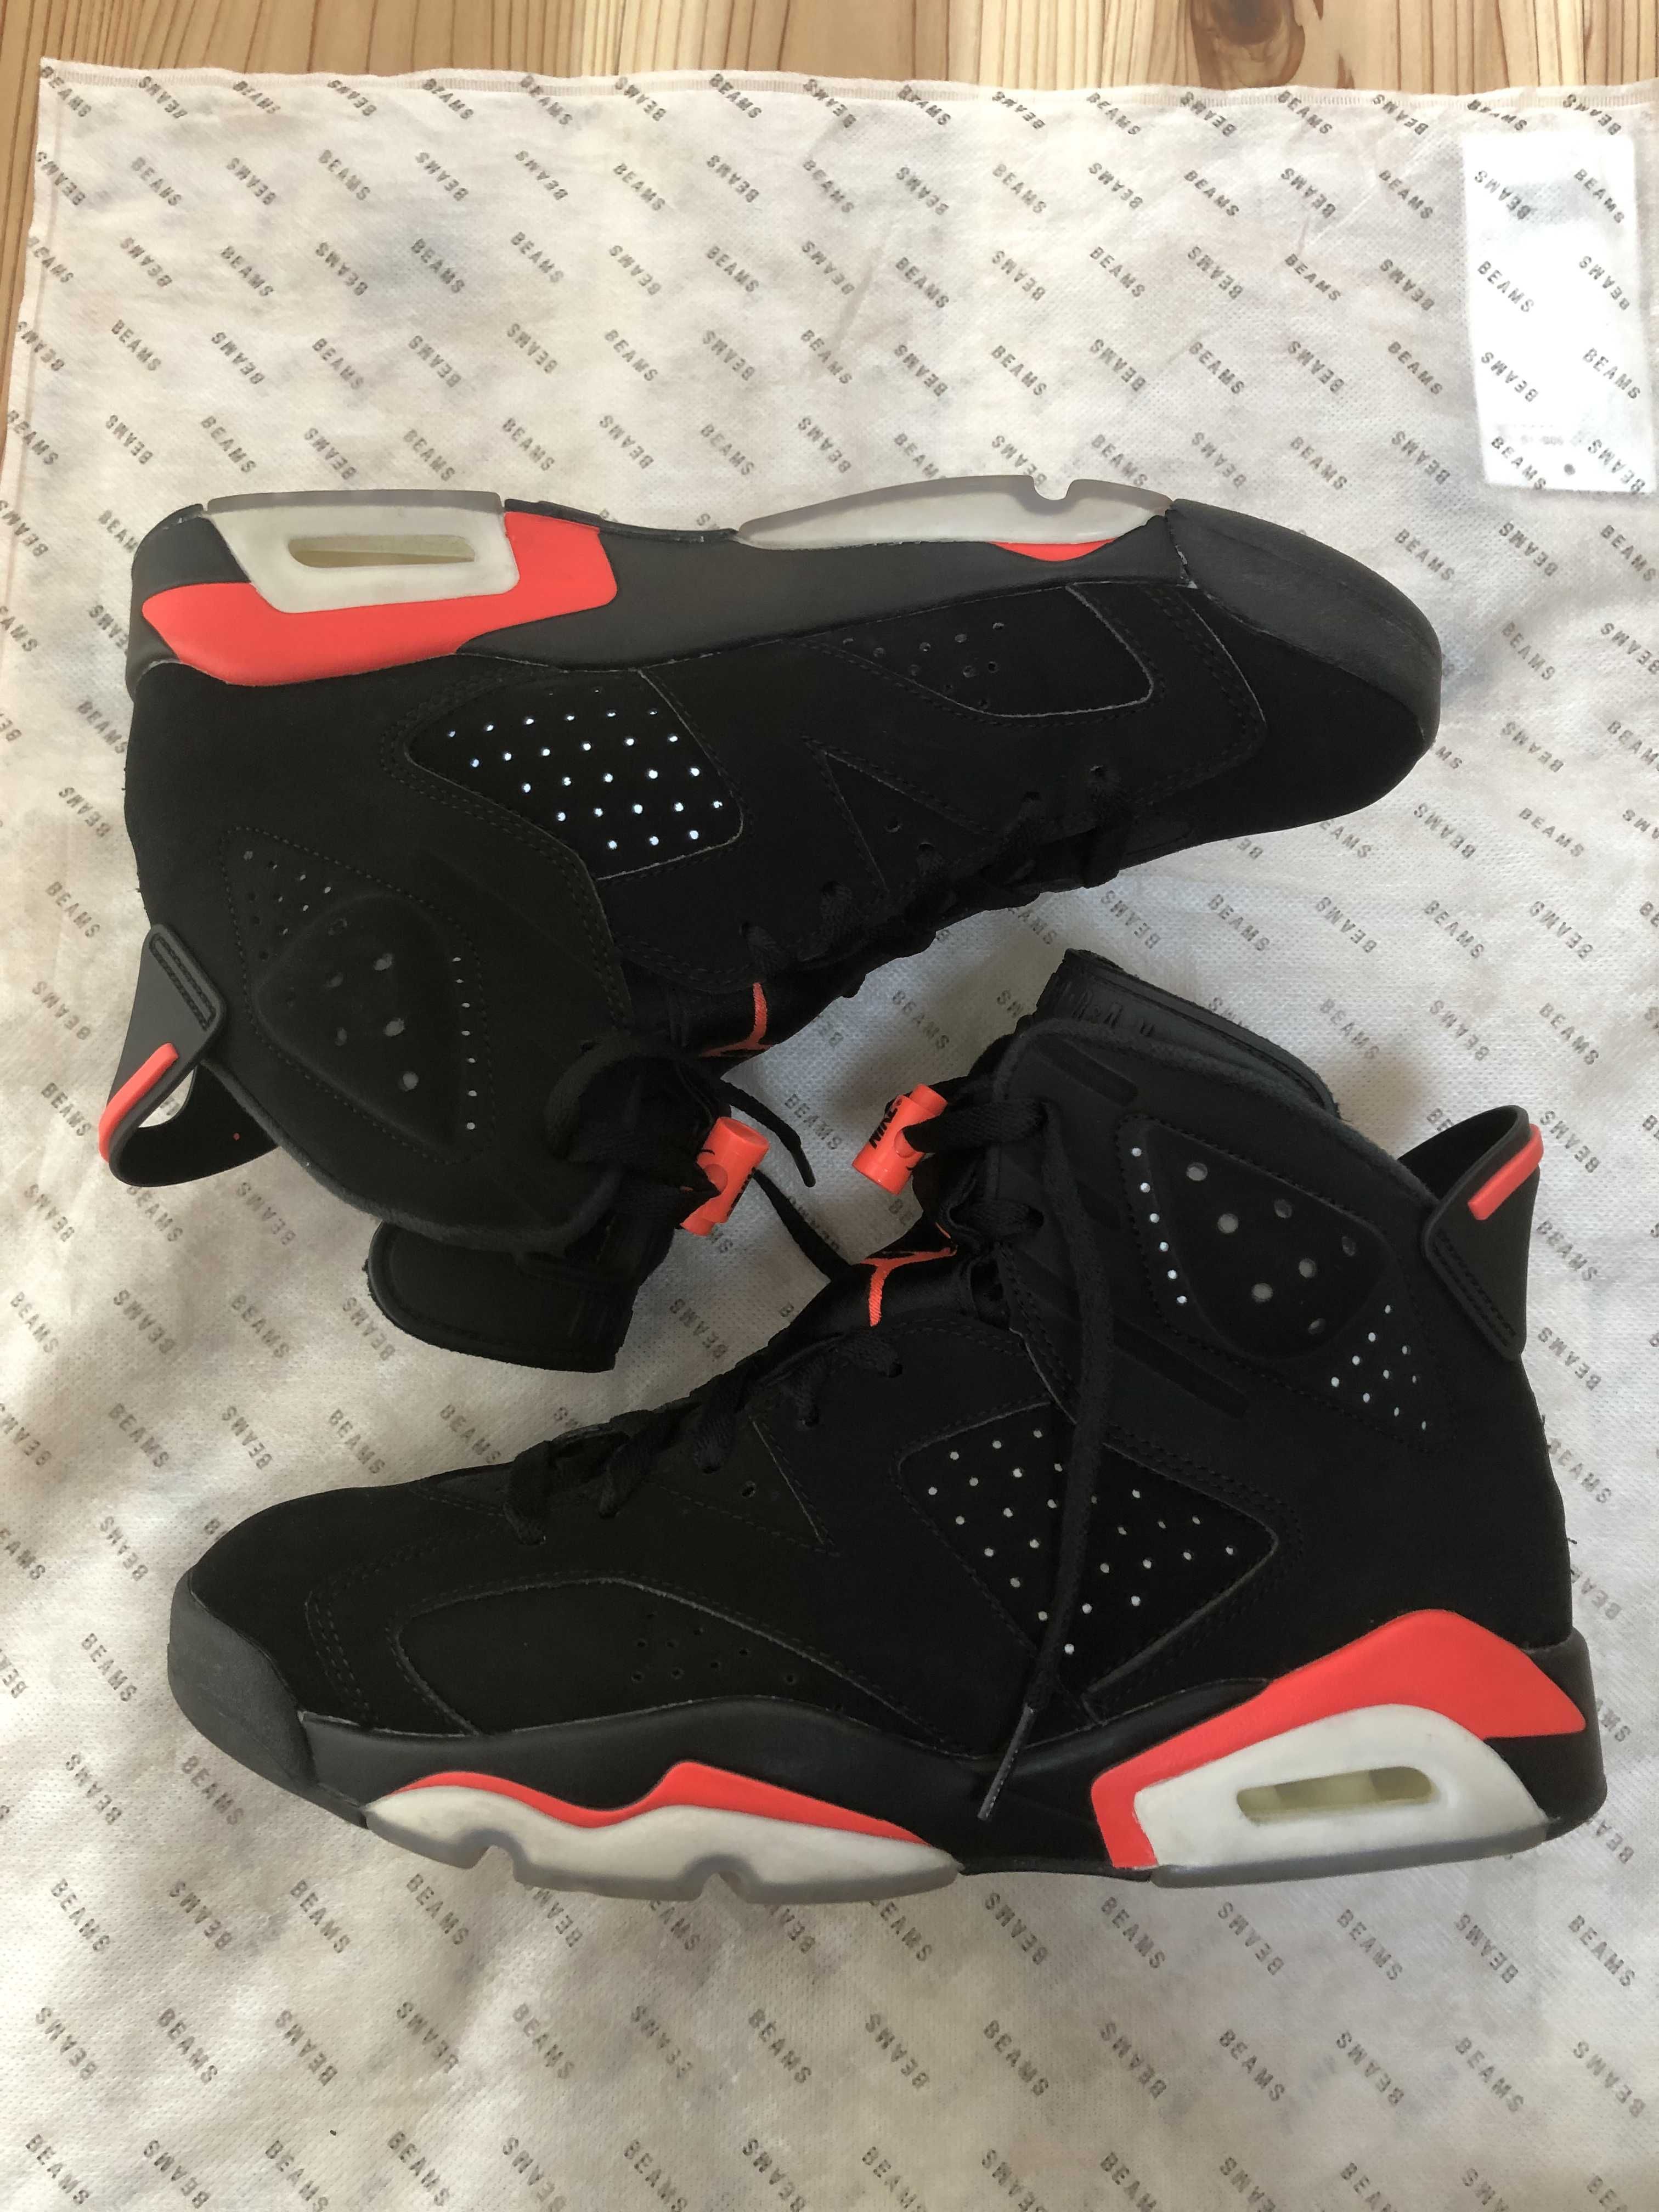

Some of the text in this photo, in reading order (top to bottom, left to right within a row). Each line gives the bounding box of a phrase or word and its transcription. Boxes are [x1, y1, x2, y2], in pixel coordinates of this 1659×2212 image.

[40, 66, 92, 117] BEAMS
[709, 74, 763, 119] BEAMS
[1086, 92, 1142, 136] BEAMS
[1278, 89, 1333, 135] BEAMS
[36, 151, 86, 206] BEAMS
[132, 157, 182, 206] BEAMS
[227, 158, 277, 205] BEAMS
[319, 150, 370, 201] BEAMS
[416, 153, 469, 201] BEAMS
[515, 151, 568, 200] BEAMS
[613, 163, 665, 211] BEAMS
[707, 155, 759, 202] BEAMS
[803, 160, 854, 213] BEAMS
[896, 167, 949, 215] BEAMS
[993, 165, 1046, 213] BEAMS
[1089, 163, 1143, 209] BEAMS
[1184, 170, 1239, 217] BEAMS
[1281, 168, 1336, 219] BEAMS
[1379, 170, 1433, 219] BEAMS
[1474, 170, 1532, 220] BEAMS
[1574, 168, 1625, 224] BEAMS
[121, 238, 172, 287] BEAMS
[221, 246, 274, 296] BEAMS
[315, 242, 368, 296] BEAMS
[411, 239, 465, 293] BEAMS
[511, 232, 562, 283] BEAMS
[610, 246, 661, 295] BEAMS
[706, 246, 759, 292] BEAMS
[802, 241, 855, 294] BEAMS
[895, 257, 949, 309] BEAMS
[992, 251, 1045, 301] BEAMS
[1090, 247, 1144, 297] BEAMS
[1187, 246, 1243, 300] BEAMS
[1284, 253, 1341, 301] BEAMS
[1579, 256, 1629, 310] BEAMS
[1380, 259, 1435, 311] BEAMS
[1478, 261, 1534, 313] BEAMS
[17, 321, 65, 371] BEAMS
[111, 320, 161, 371] BEAMS
[211, 332, 265, 385] BEAMS
[313, 338, 364, 390] BEAMS
[409, 336, 461, 388] BEAMS
[507, 323, 557, 373] BEAMS
[605, 330, 657, 381] BEAMS
[703, 331, 755, 381] BEAMS
[802, 330, 851, 384] BEAMS
[894, 344, 947, 398] BEAMS
[991, 345, 1047, 396] BEAMS
[1090, 339, 1146, 393] BEAMS
[1189, 341, 1245, 394] BEAMS
[1286, 341, 1345, 394] BEAMS
[1388, 342, 1442, 395] BEAMS
[1481, 352, 1537, 402] BEAMS
[1583, 348, 1640, 399] BEAMS
[8, 410, 59, 465] BEAMS
[106, 415, 153, 465] BEAMS
[201, 416, 256, 473] BEAMS
[305, 428, 357, 479] BEAMS
[404, 430, 455, 481] BEAMS
[502, 418, 555, 470] BEAMS
[600, 416, 653, 469] BEAMS
[701, 425, 754, 475] BEAMS
[798, 417, 851, 472] BEAMS
[1091, 434, 1148, 487] BEAMS
[1192, 433, 1246, 488] BEAMS
[1290, 437, 1347, 489] BEAMS
[1392, 432, 1451, 484] BEAMS
[1491, 436, 1547, 490] BEAMS
[1587, 438, 1646, 495] BEAMS
[1395, 529, 1454, 580] BEAMS
[1499, 522, 1558, 577] BEAMS
[1600, 525, 1656, 582] BEAMS
[1502, 621, 1554, 680] BEAMS
[1502, 722, 1564, 772] BEAMS
[59, 787, 111, 838] BEAMS
[1414, 804, 1476, 859] BEAMS
[1519, 808, 1584, 857] BEAMS
[47, 882, 100, 937] BEAMS
[1101, 889, 1161, 949] BEAMS
[1209, 894, 1269, 951] BEAMS
[1316, 897, 1376, 953] BEAMS
[1423, 900, 1484, 959] BEAMS
[1530, 901, 1593, 959] BEAMS
[1430, 1001, 1489, 1060] BEAMS
[1540, 1003, 1599, 1065] BEAMS
[41, 1082, 91, 1136] BEAMS
[785, 1093, 843, 1151] BEAMS
[1540, 1110, 1601, 1173] BEAMS
[24, 1183, 75, 1243] BEAMS
[235, 1182, 297, 1246] BEAMS
[1537, 1220, 1598, 1282] BEAMS
[10, 1291, 59, 1354] BEAMS
[114, 1290, 176, 1355] BEAMS
[232, 1296, 289, 1358] BEAMS
[342, 1296, 396, 1362] BEAMS
[1538, 1327, 1602, 1391] BEAMS
[109, 1403, 170, 1468] BEAMS
[221, 1405, 273, 1470] BEAMS
[329, 1409, 385, 1474] BEAMS
[101, 1517, 148, 1581] BEAMS
[82, 1633, 137, 1701] BEAMS
[65, 1754, 122, 1825] BEAMS
[182, 1757, 244, 1825] BEAMS
[52, 1879, 110, 1951] BEAMS
[169, 1881, 233, 1950] BEAMS
[290, 1880, 350, 1953] BEAMS
[406, 1874, 470, 1946] BEAMS
[985, 1893, 1048, 1965] BEAMS
[1101, 1897, 1165, 1968] BEAMS
[1218, 1903, 1284, 1975] BEAMS
[1338, 1909, 1402, 1980] BEAMS
[1455, 1914, 1518, 1983] BEAMS
[1568, 1915, 1635, 1987] BEAMS
[36, 2007, 97, 2080] BEAMS
[157, 2008, 217, 2083] BEAMS
[275, 2010, 338, 2086] BEAMS
[397, 2002, 459, 2072] BEAMS
[514, 2005, 574, 2079] BEAMS
[749, 2009, 811, 2084] BEAMS
[865, 2015, 929, 2088] BEAMS
[983, 2021, 1049, 2096] BEAMS
[1101, 2022, 1166, 2098] BEAMS
[1219, 2030, 1285, 2101] BEAMS
[1336, 2032, 1404, 2106] BEAMS
[1455, 2038, 1523, 2112] BEAMS
[1573, 2042, 1645, 2118] BEAMS
[25, 2134, 89, 2205] BEAMS
[143, 2140, 210, 2209] BEAMS
[387, 2131, 449, 2206] BEAMS
